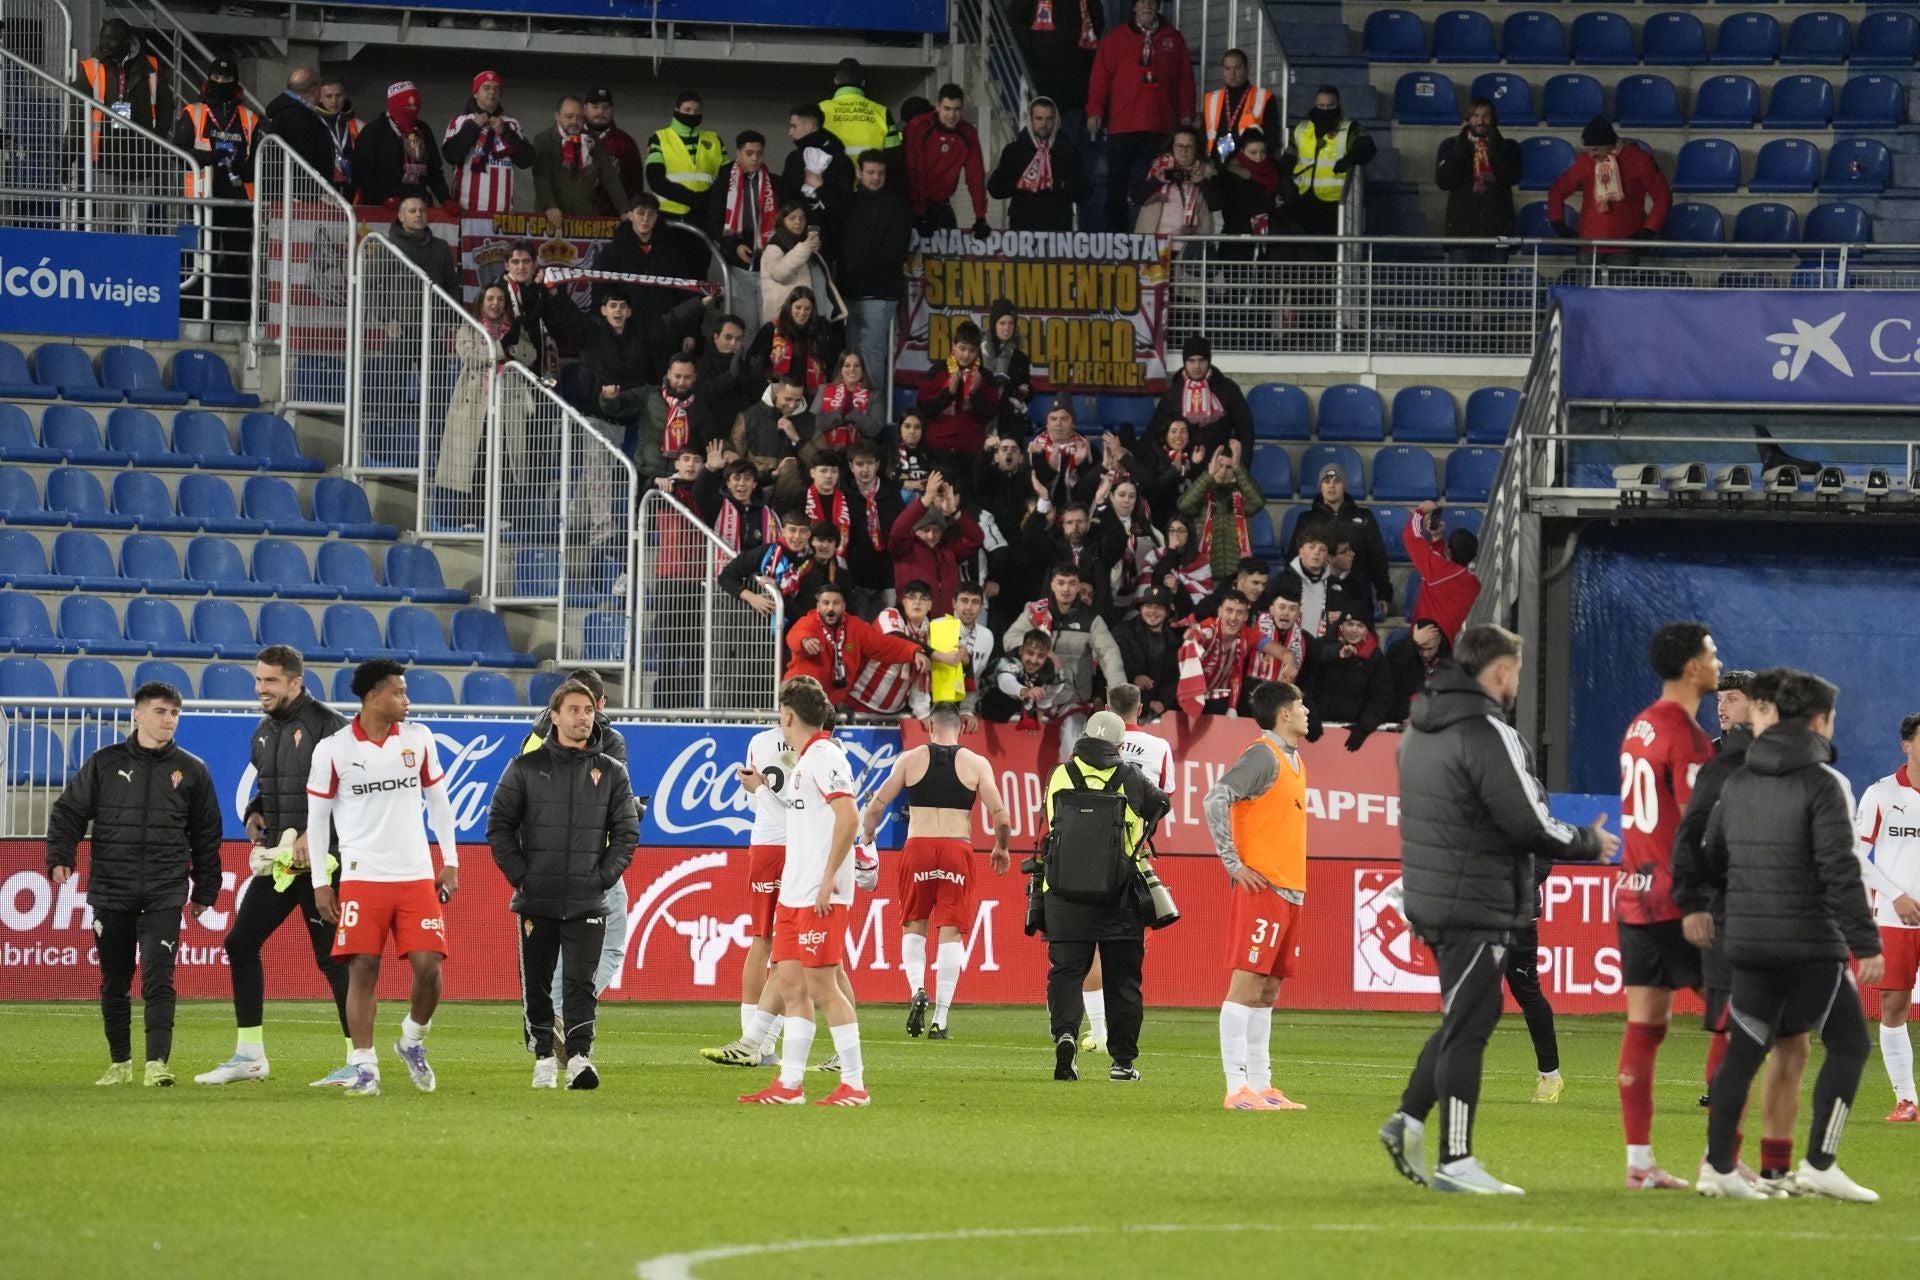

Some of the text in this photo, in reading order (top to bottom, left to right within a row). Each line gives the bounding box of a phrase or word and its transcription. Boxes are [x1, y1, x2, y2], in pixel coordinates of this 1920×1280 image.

[0, 255, 161, 307] cón viajes
[923, 259, 1139, 315] SENTIMIENTO
[1048, 360, 1069, 385] LA
[1620, 752, 1659, 834] 20
[914, 869, 966, 886] NISSAN
[339, 901, 359, 928] 16
[1251, 917, 1280, 948] 31
[0, 942, 78, 966] brica
